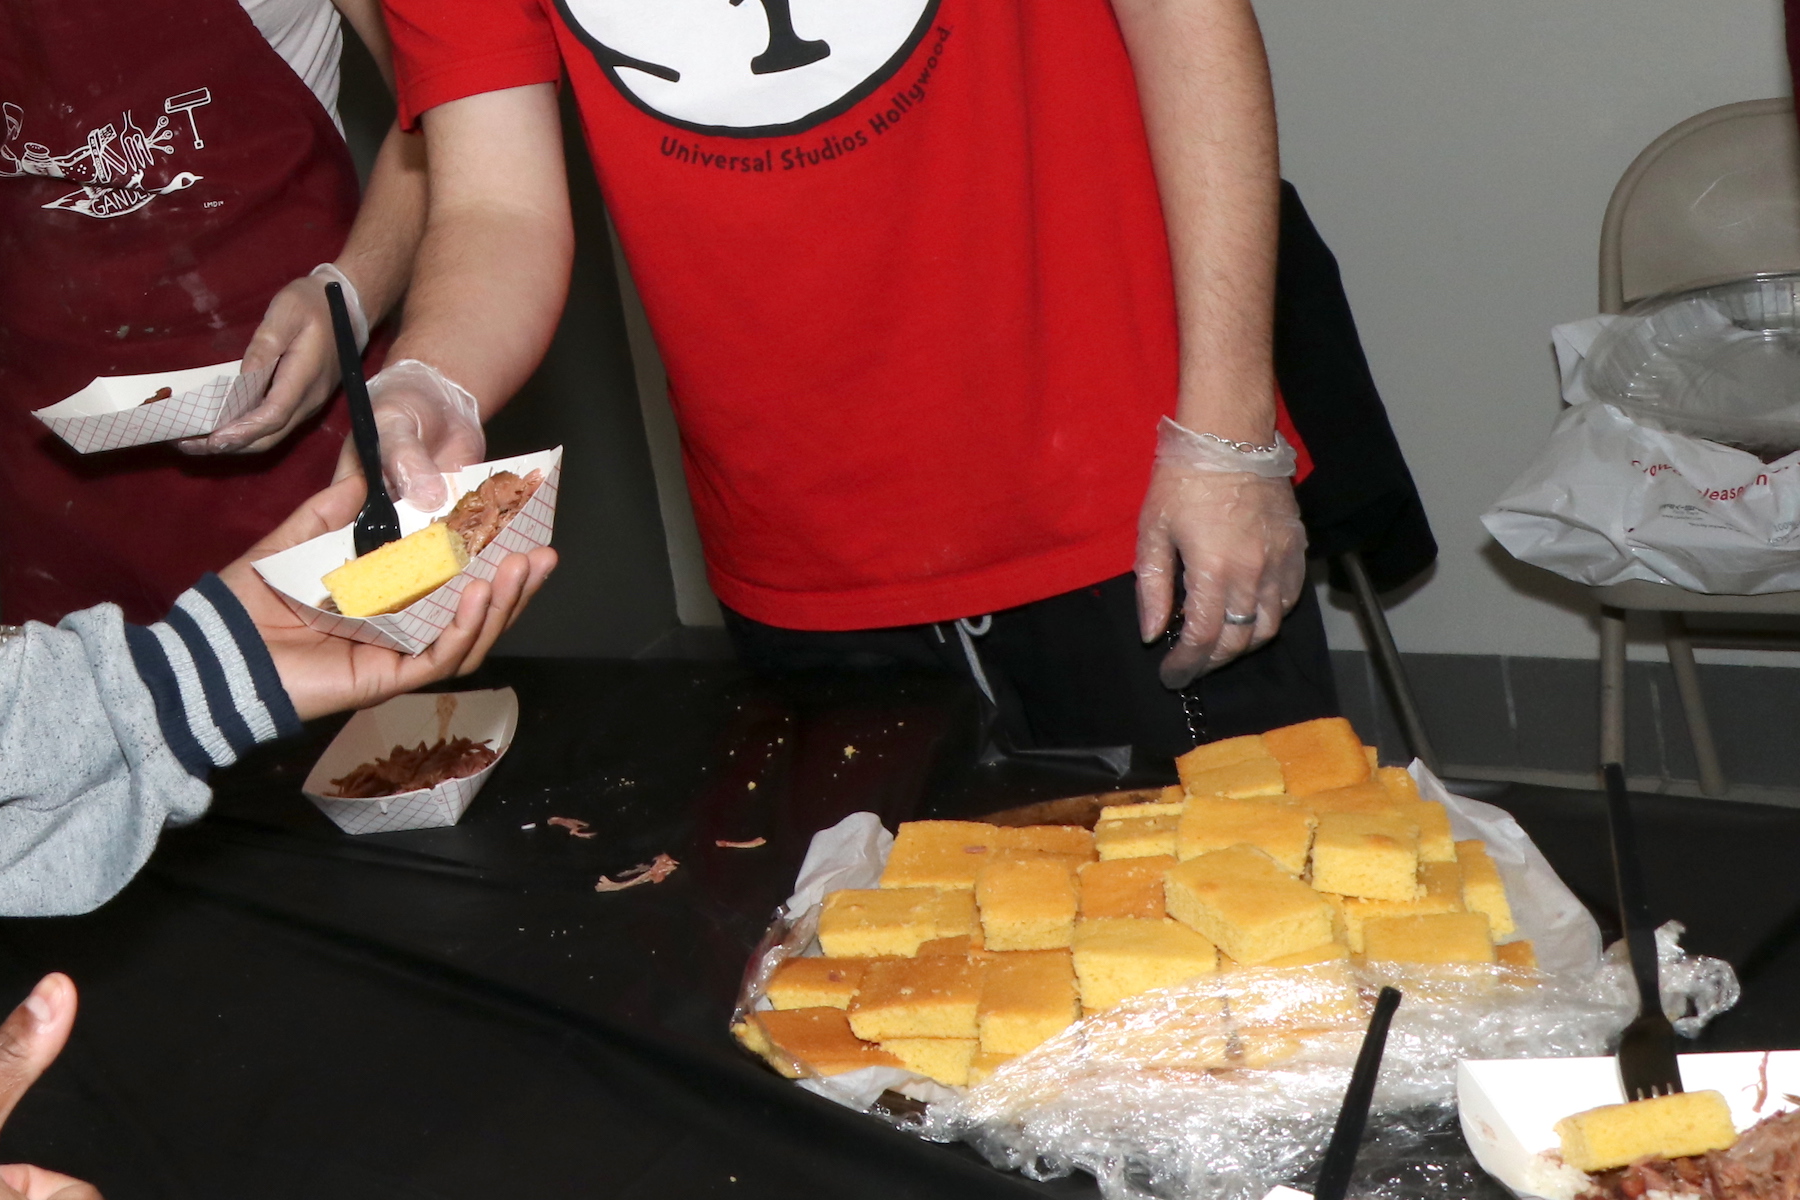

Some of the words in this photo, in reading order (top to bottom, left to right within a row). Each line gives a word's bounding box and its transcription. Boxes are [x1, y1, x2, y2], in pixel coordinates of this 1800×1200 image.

[660, 135, 773, 173] Universal
[781, 129, 869, 172] Studios
[869, 25, 950, 136] Hollywood
